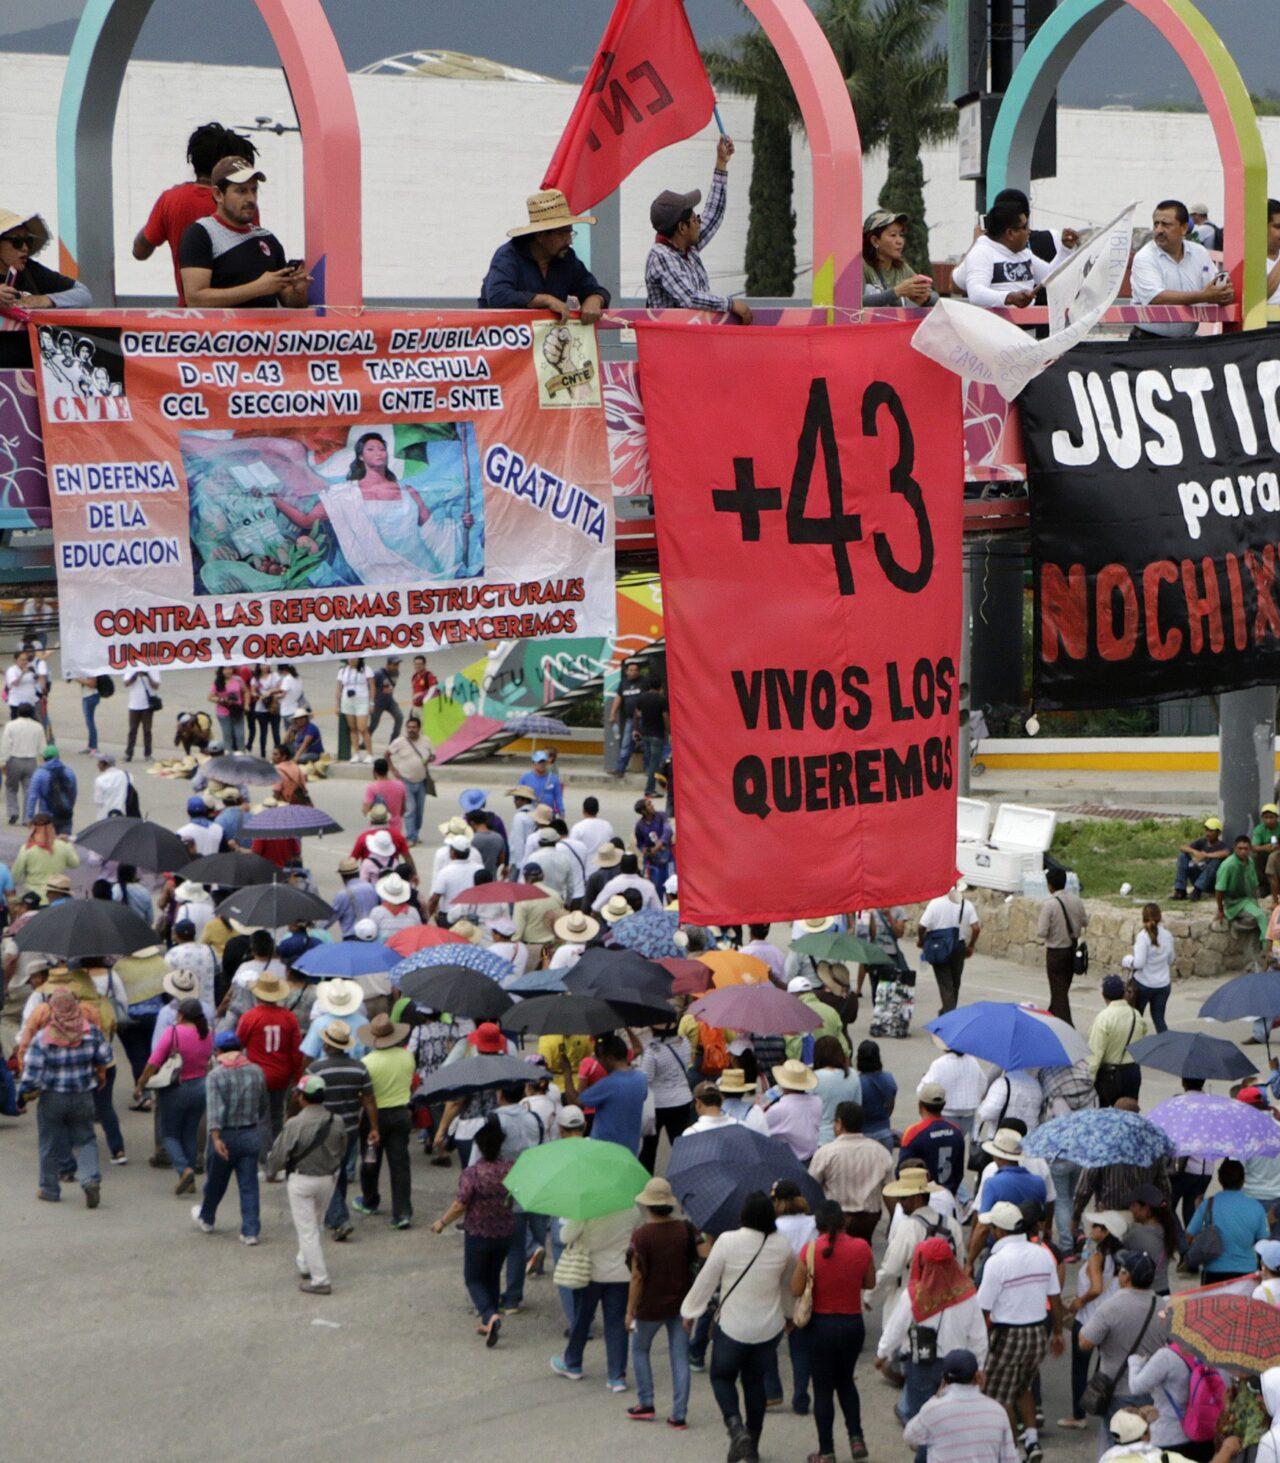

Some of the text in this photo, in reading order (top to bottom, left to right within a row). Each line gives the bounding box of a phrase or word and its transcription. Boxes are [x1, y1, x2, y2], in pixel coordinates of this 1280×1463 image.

[125, 327, 530, 354] DELEGACION SINDICAL DE JUBILADOS
[311, 362, 339, 381] DE
[366, 358, 488, 381] TAPACHULA
[562, 370, 591, 386] CNTE
[53, 395, 131, 421] CNTE
[163, 396, 206, 416] CCL
[231, 393, 325, 415] SECCION
[328, 392, 358, 412] VII
[382, 390, 433, 412] CNTE
[450, 388, 501, 407] SNTE
[56, 465, 175, 491] EN DEFENSA
[712, 377, 934, 596] +43
[486, 447, 606, 543] GRATUITA
[1178, 472, 1280, 539] para
[89, 504, 146, 528] DE LA
[62, 540, 179, 569] EDUCACION
[94, 578, 585, 637] CONTRA LAS REFORMAS ESTRUCTURALES
[108, 609, 577, 670] UNIDOS Y ORGANIZADOS VENCEREMOS
[731, 656, 955, 731] VIVOS LOS
[732, 735, 953, 820] QUEREMOS
[263, 1024, 280, 1053] 11
[937, 1146, 953, 1184] 5
